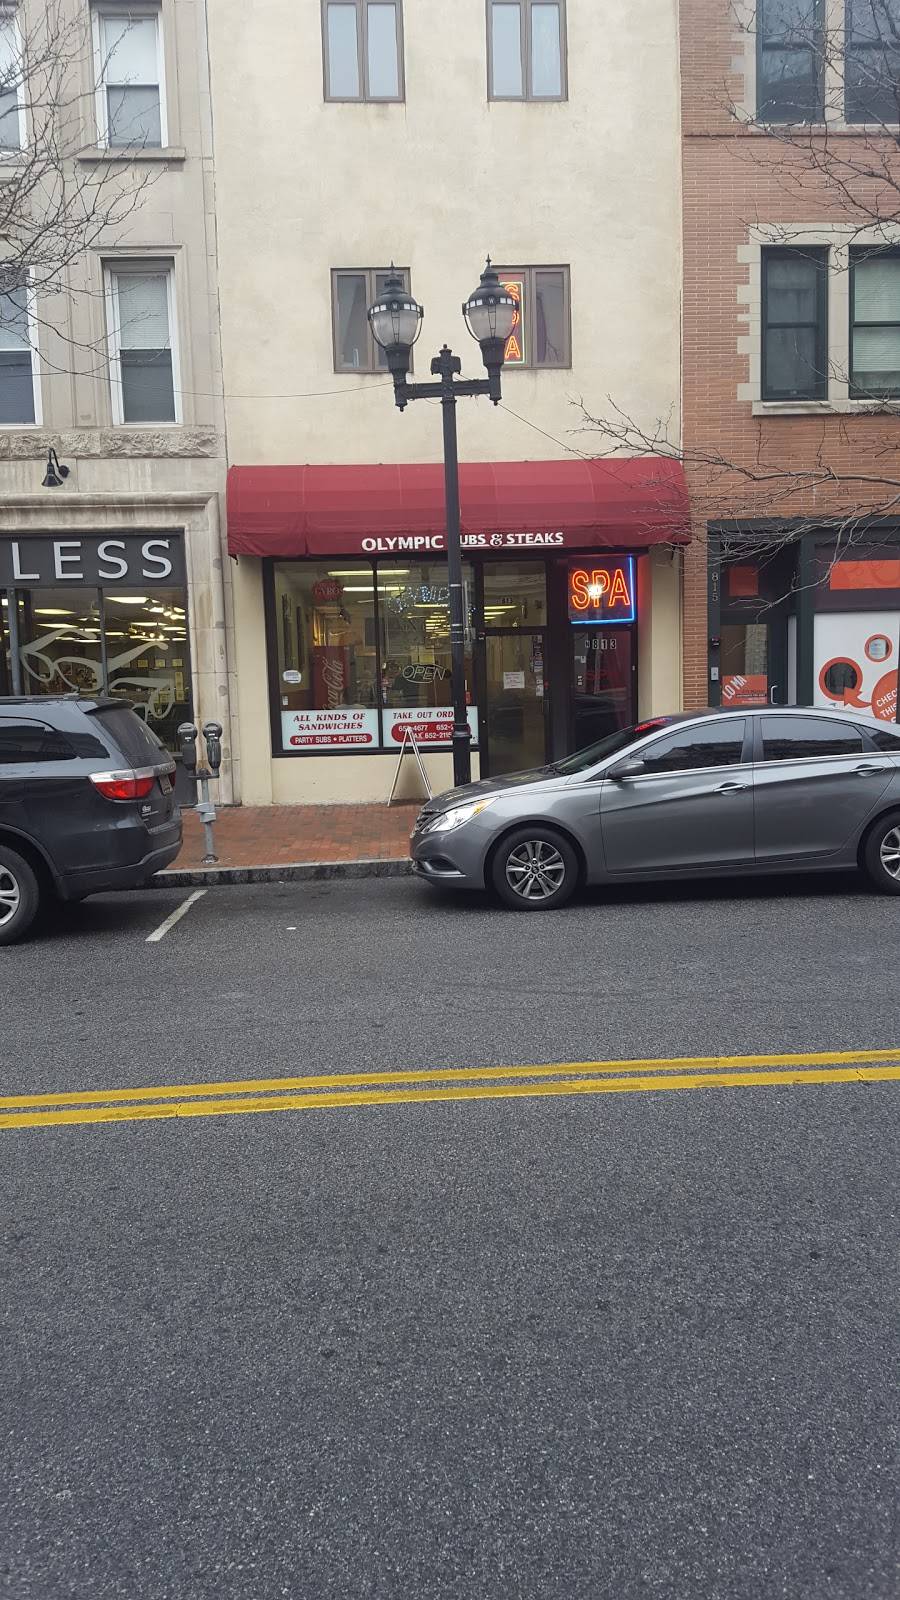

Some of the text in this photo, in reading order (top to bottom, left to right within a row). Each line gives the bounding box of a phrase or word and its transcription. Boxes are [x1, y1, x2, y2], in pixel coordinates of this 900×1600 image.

[361, 532, 564, 551] OLYMPIC UBS & STEAKS
[11, 540, 173, 580] LESS
[572, 568, 630, 609] SPA
[593, 639, 617, 649] 813
[402, 665, 446, 680] OPEN
[876, 688, 897, 707] CHEC
[298, 722, 363, 731] SANDWICHES
